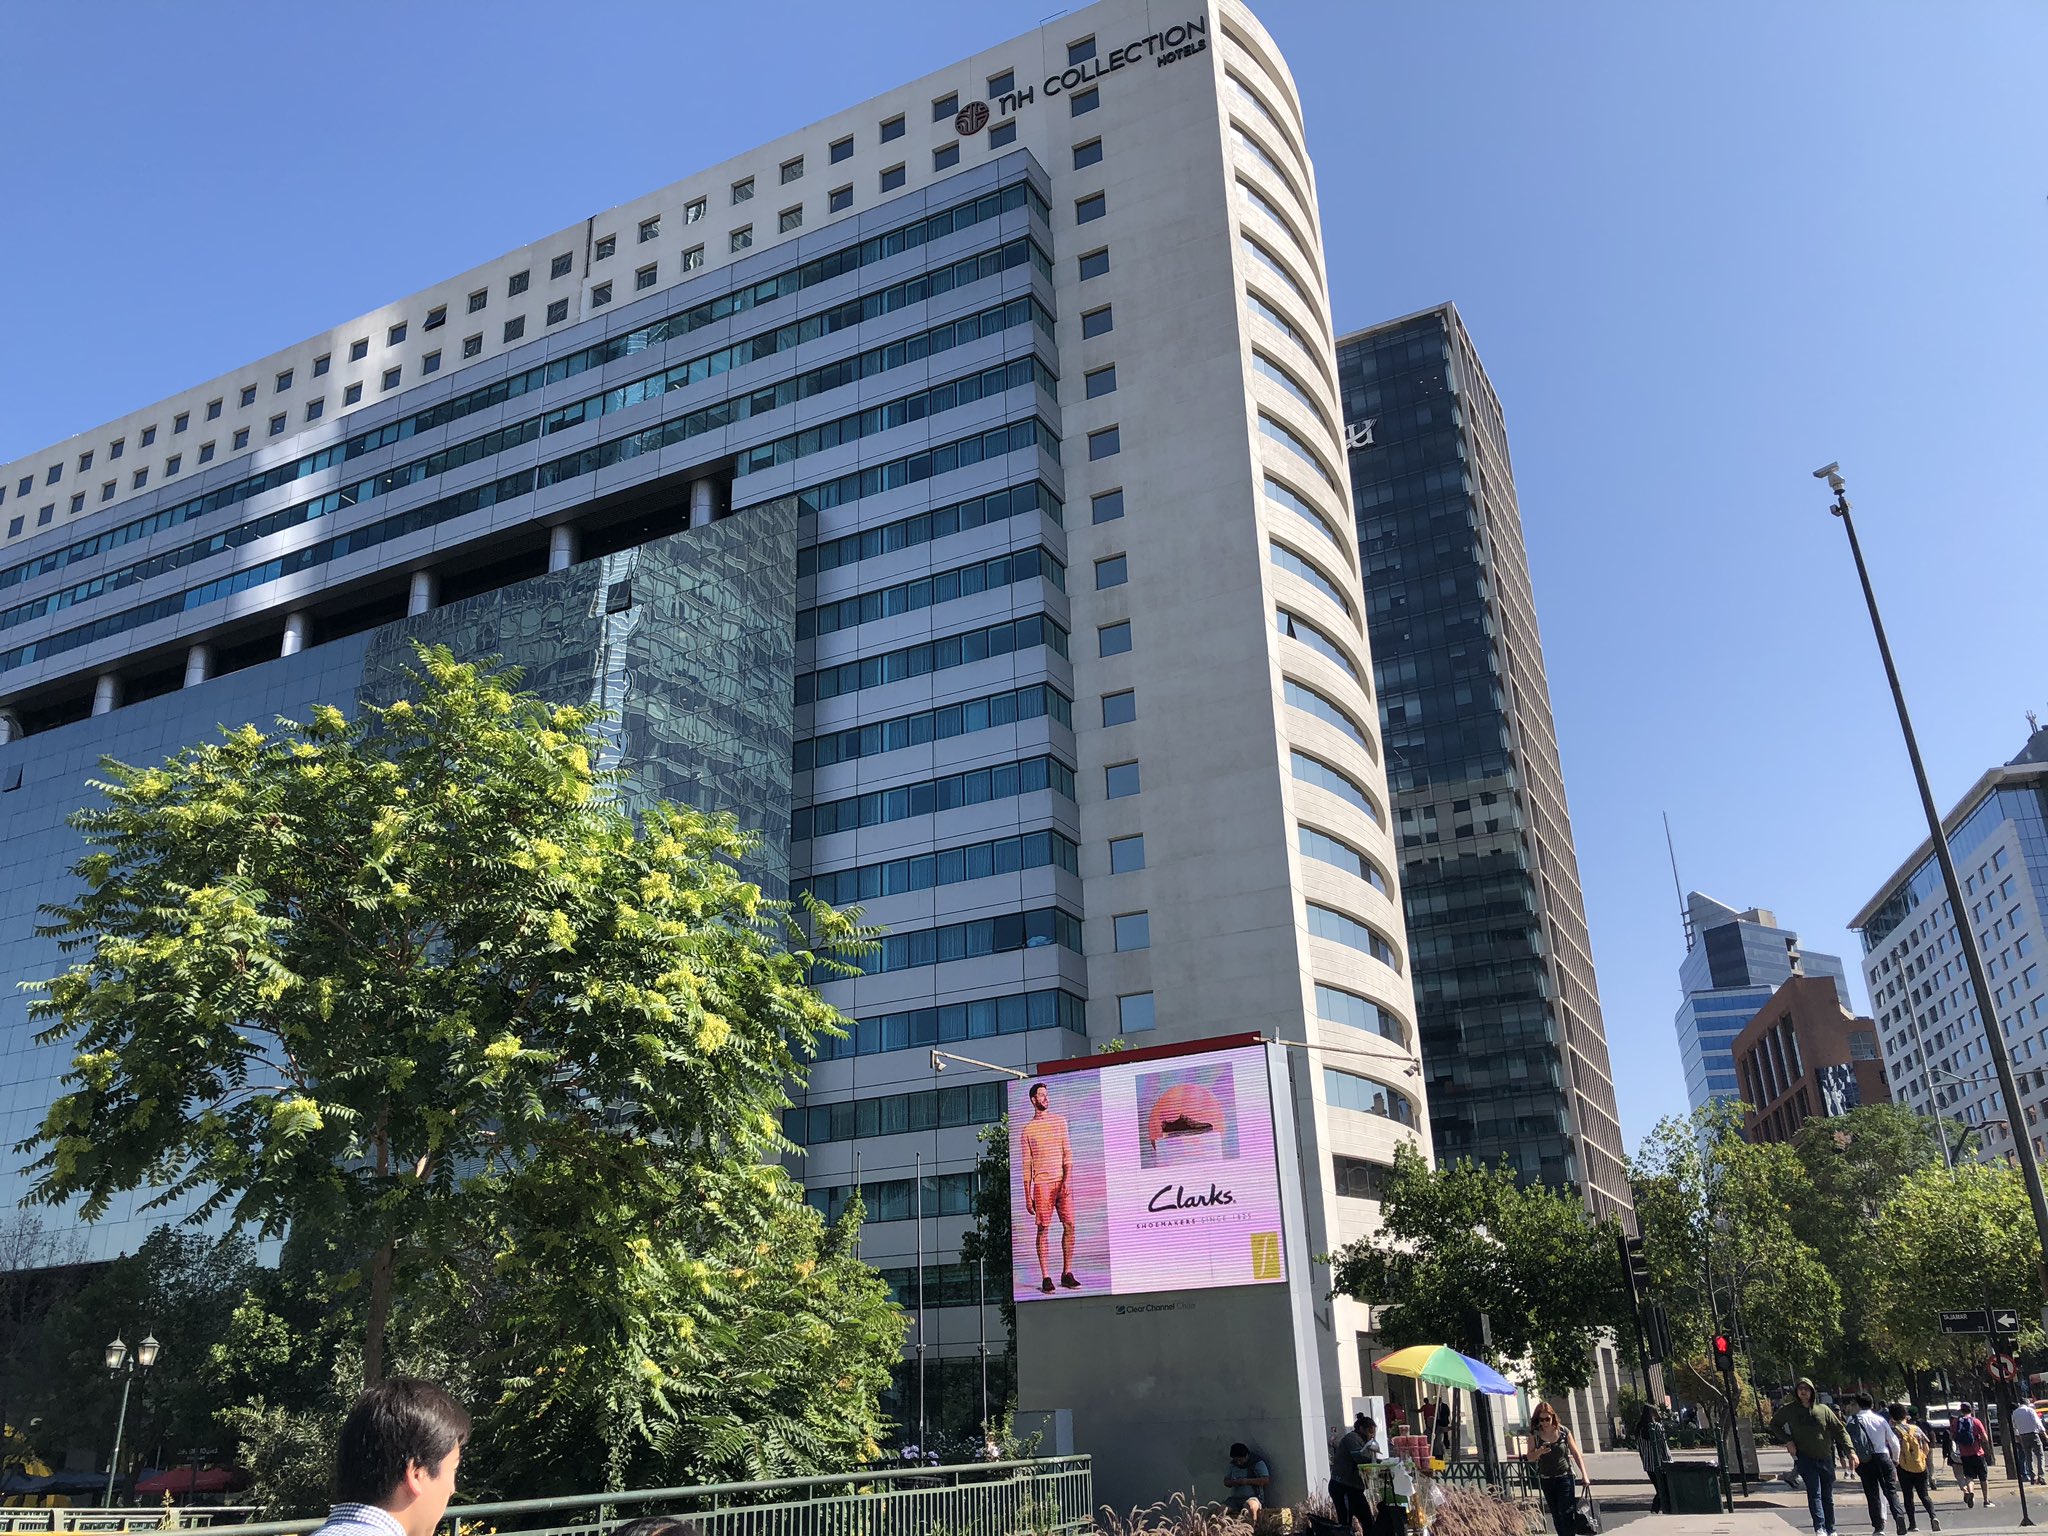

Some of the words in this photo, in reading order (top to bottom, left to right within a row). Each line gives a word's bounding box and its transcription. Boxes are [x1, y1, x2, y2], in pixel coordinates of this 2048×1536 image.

[1043, 16, 1206, 97] COLLECTION
[1157, 39, 1207, 68] HOTELS
[1136, 1218, 1196, 1229] SHOEMAKERS
[1201, 1215, 1226, 1223] SINCE
[1126, 1305, 1145, 1314] Clear
[1146, 1303, 1175, 1312] Channel
